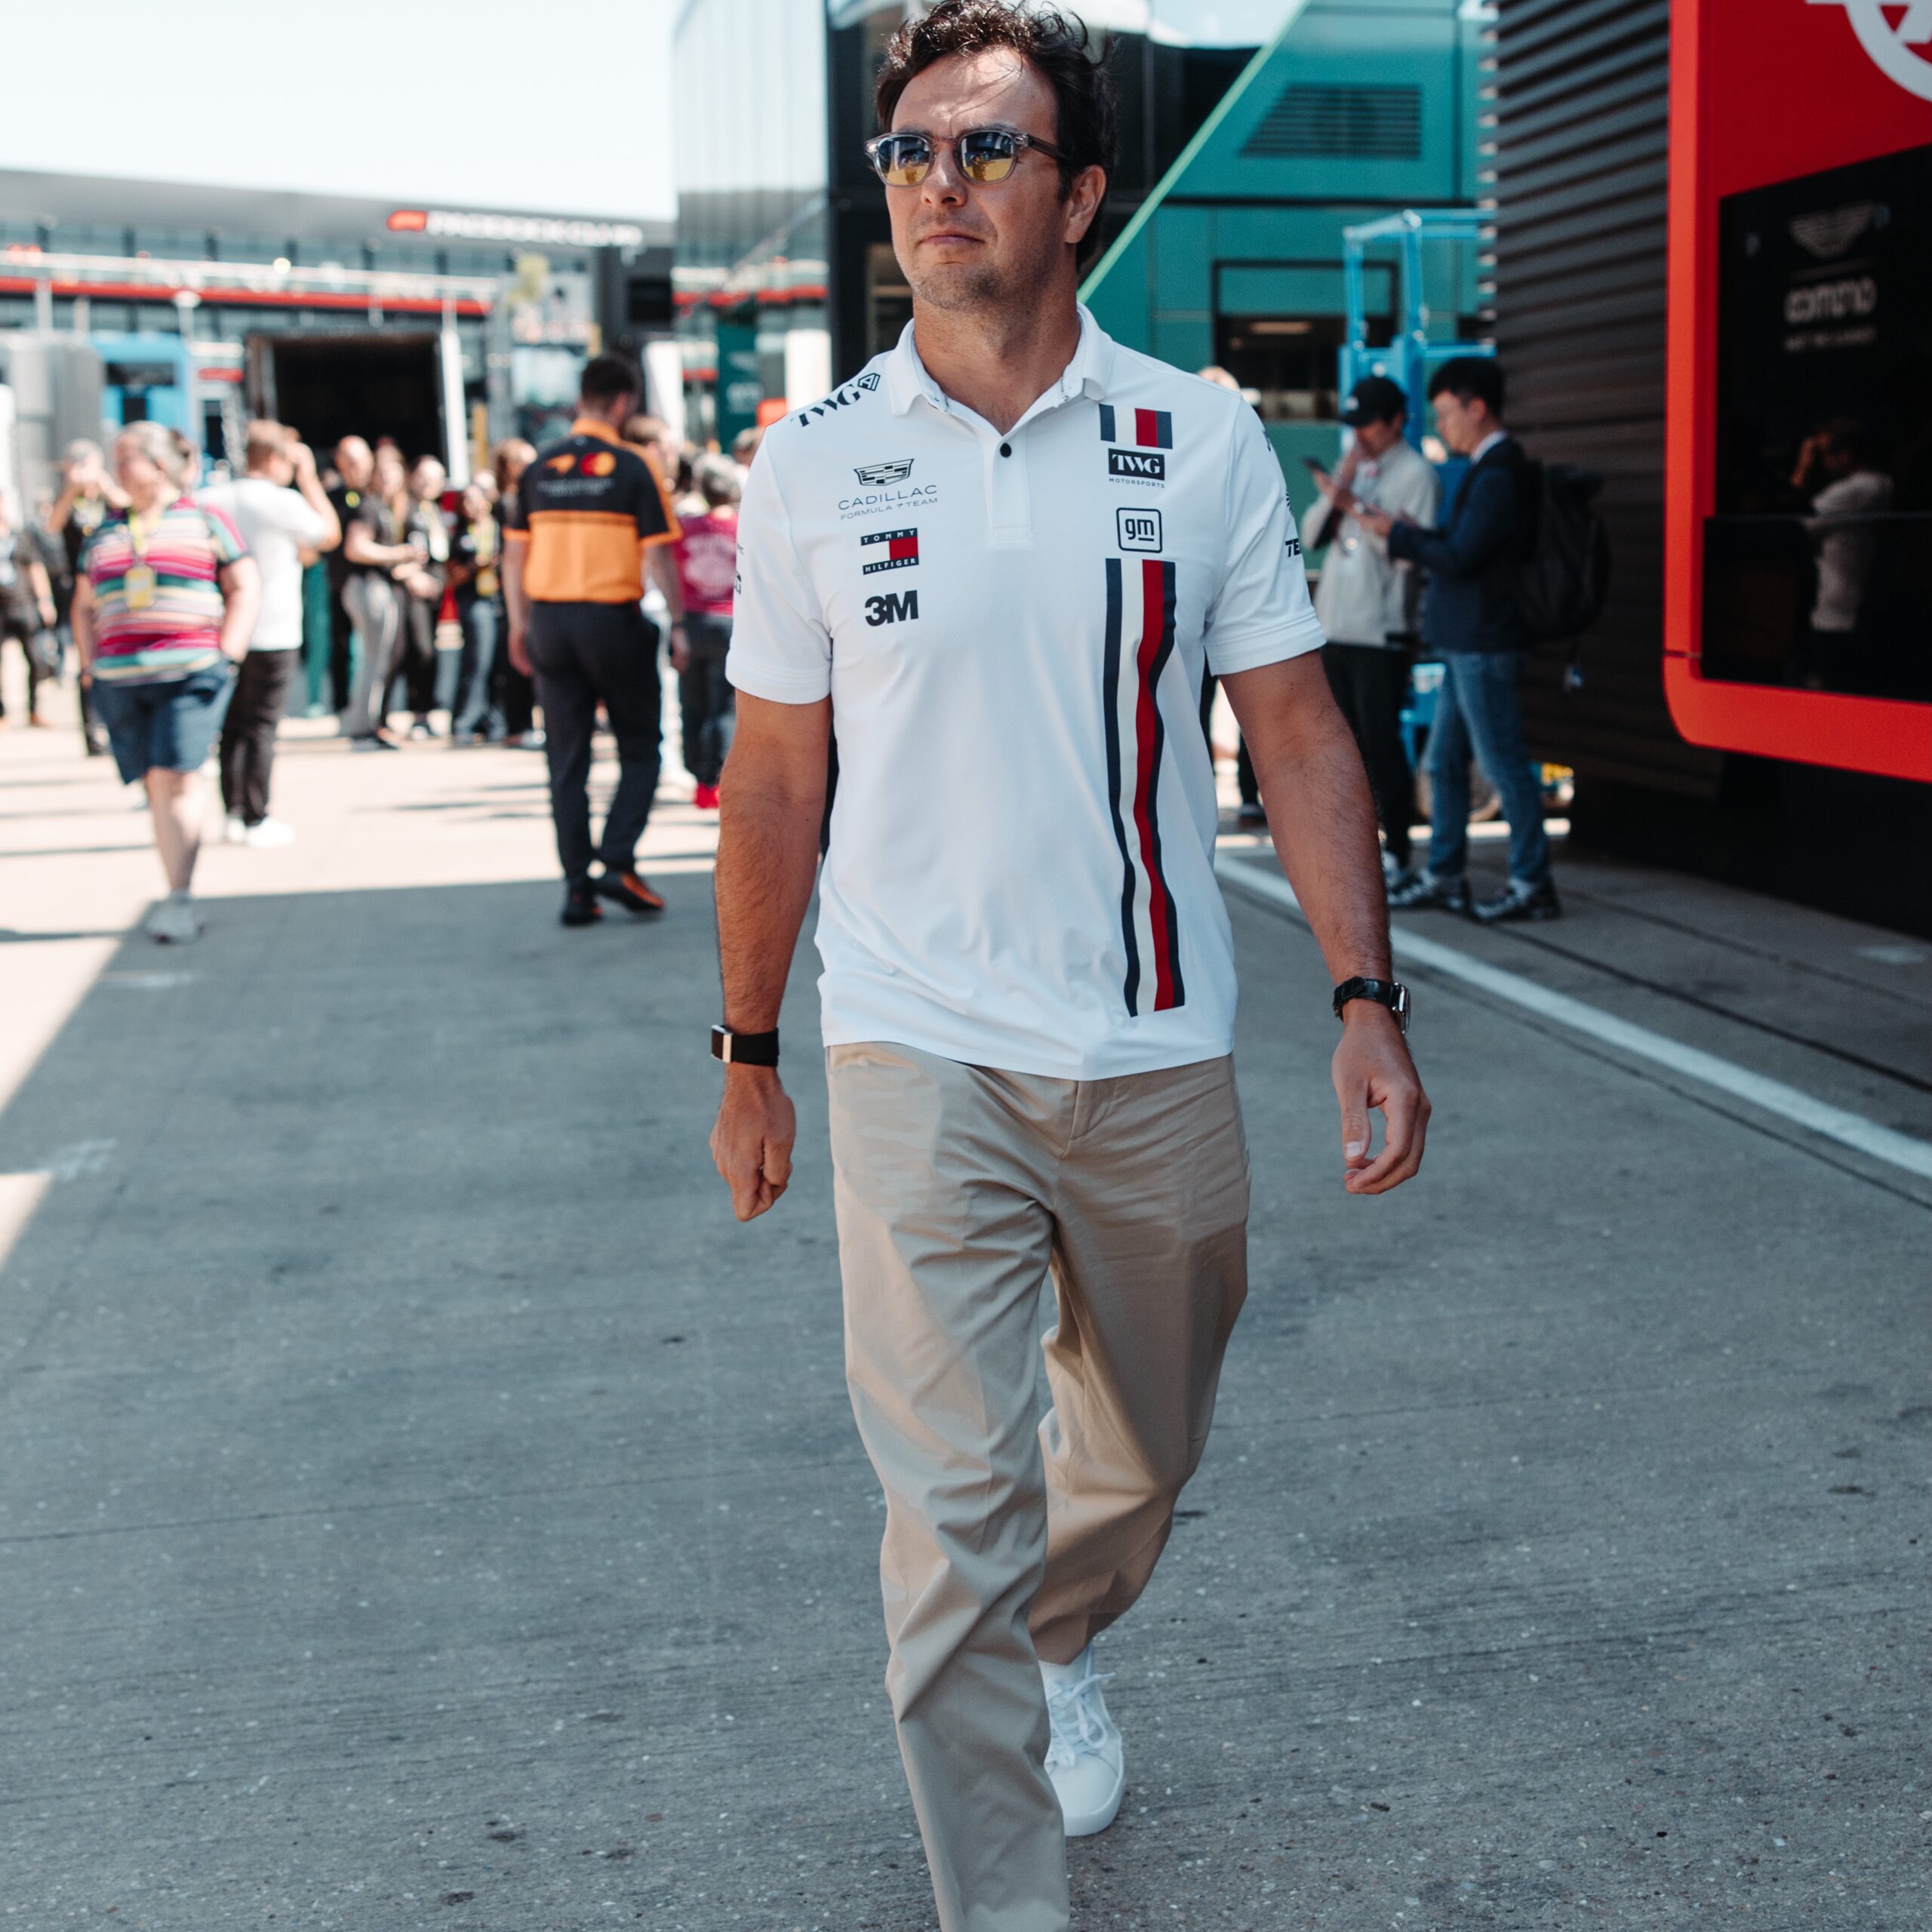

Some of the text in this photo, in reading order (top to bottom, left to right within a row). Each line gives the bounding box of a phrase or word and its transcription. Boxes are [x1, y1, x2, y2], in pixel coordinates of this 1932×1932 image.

[790, 383, 861, 428] TWG
[1112, 454, 1161, 474] TWG
[1109, 477, 1165, 489] MOTORSPORTS
[838, 485, 937, 510] CADILLAC
[840, 505, 893, 521] FORMULA
[906, 497, 938, 507] TEAM
[863, 530, 915, 543] TOMMY
[1124, 518, 1155, 542] gm
[864, 558, 916, 573] HILFIGER
[864, 589, 919, 627] 3M
